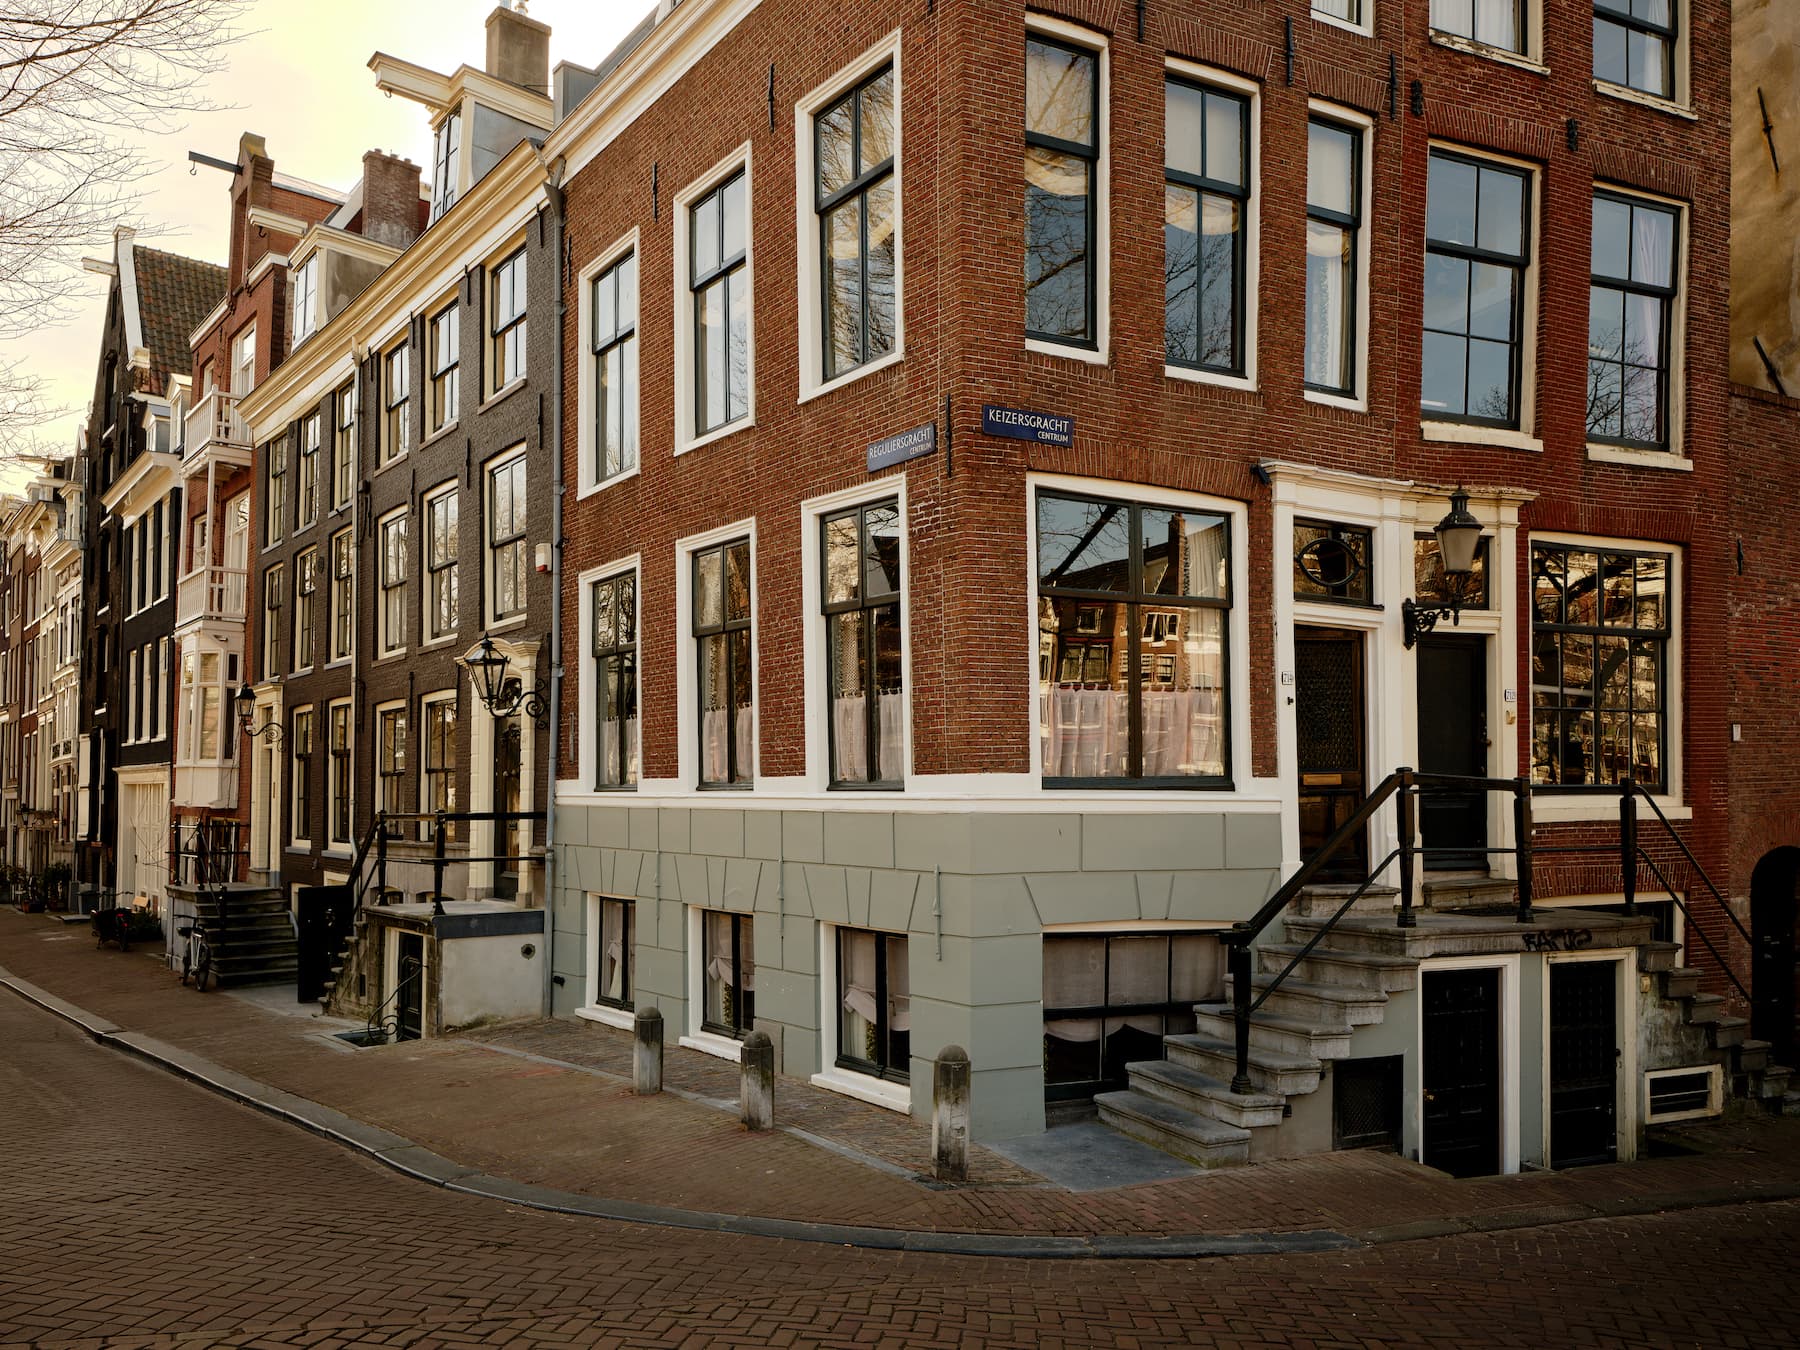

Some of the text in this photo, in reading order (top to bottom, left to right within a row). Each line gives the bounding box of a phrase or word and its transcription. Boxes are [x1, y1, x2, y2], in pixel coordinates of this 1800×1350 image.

[989, 409, 1069, 432] KEIZERSGRACHT
[869, 428, 931, 459] REGULIERSGRACHT
[1037, 430, 1069, 443] CENTRUM
[909, 442, 932, 455] CENTRUM
